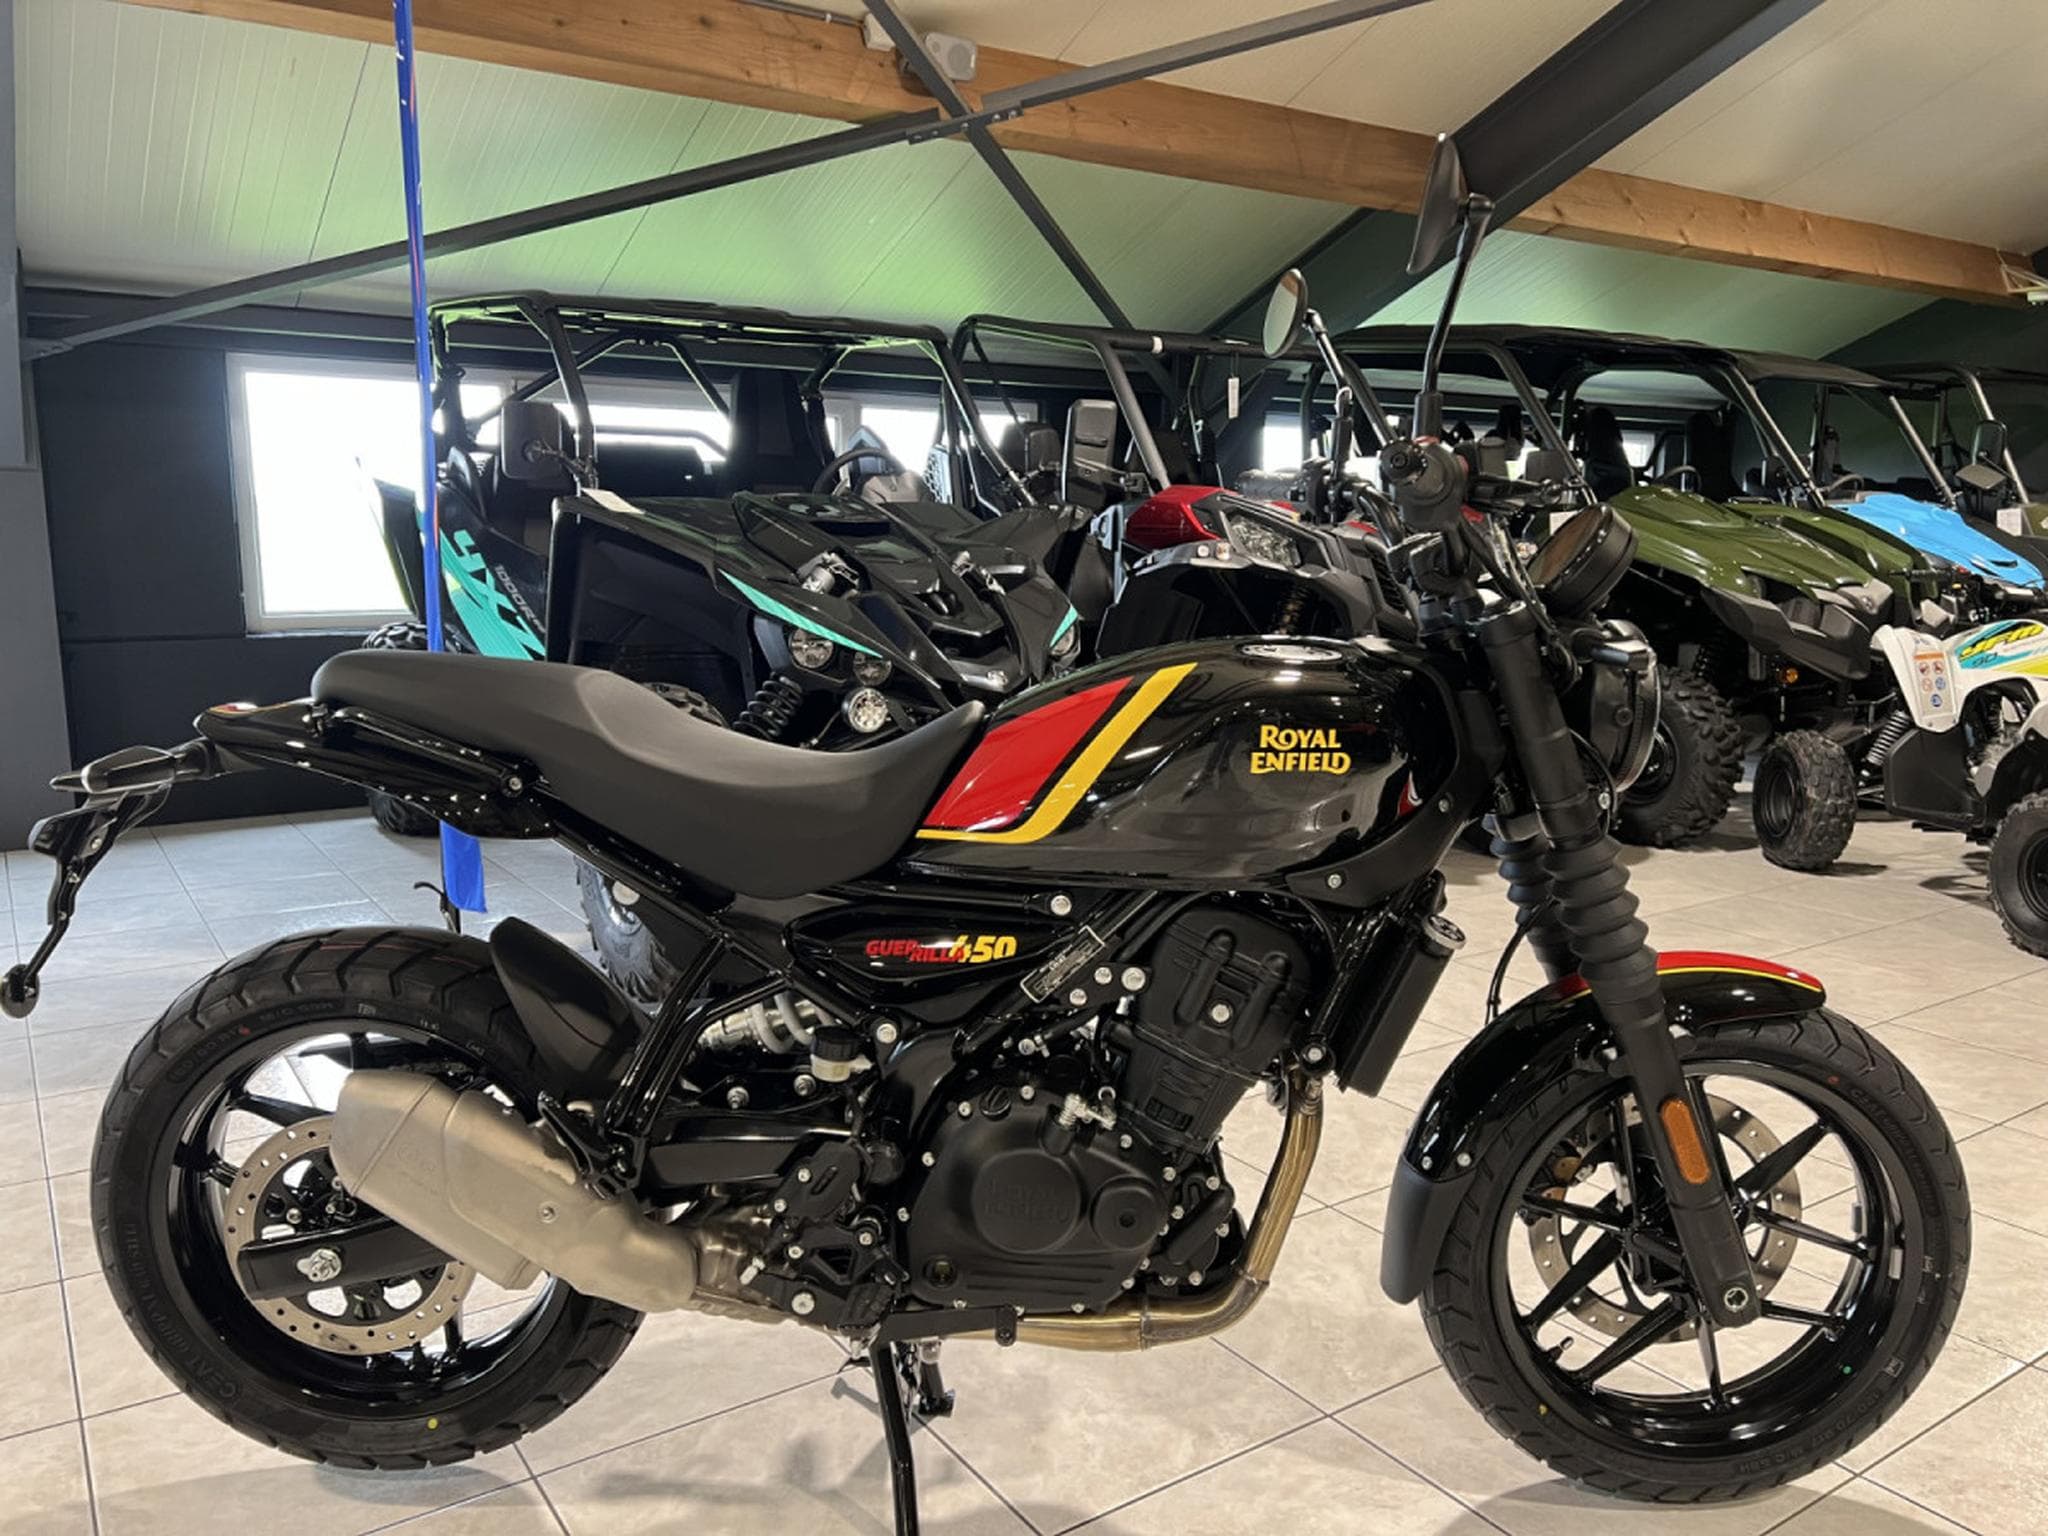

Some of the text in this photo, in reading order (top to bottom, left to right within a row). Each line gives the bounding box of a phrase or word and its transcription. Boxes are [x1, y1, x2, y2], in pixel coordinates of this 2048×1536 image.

[453, 528, 547, 661] YXZ
[1260, 724, 1342, 751] ROYAL
[1249, 751, 1352, 775] ENFIELD
[865, 934, 1018, 963] GUERRILLA 450
